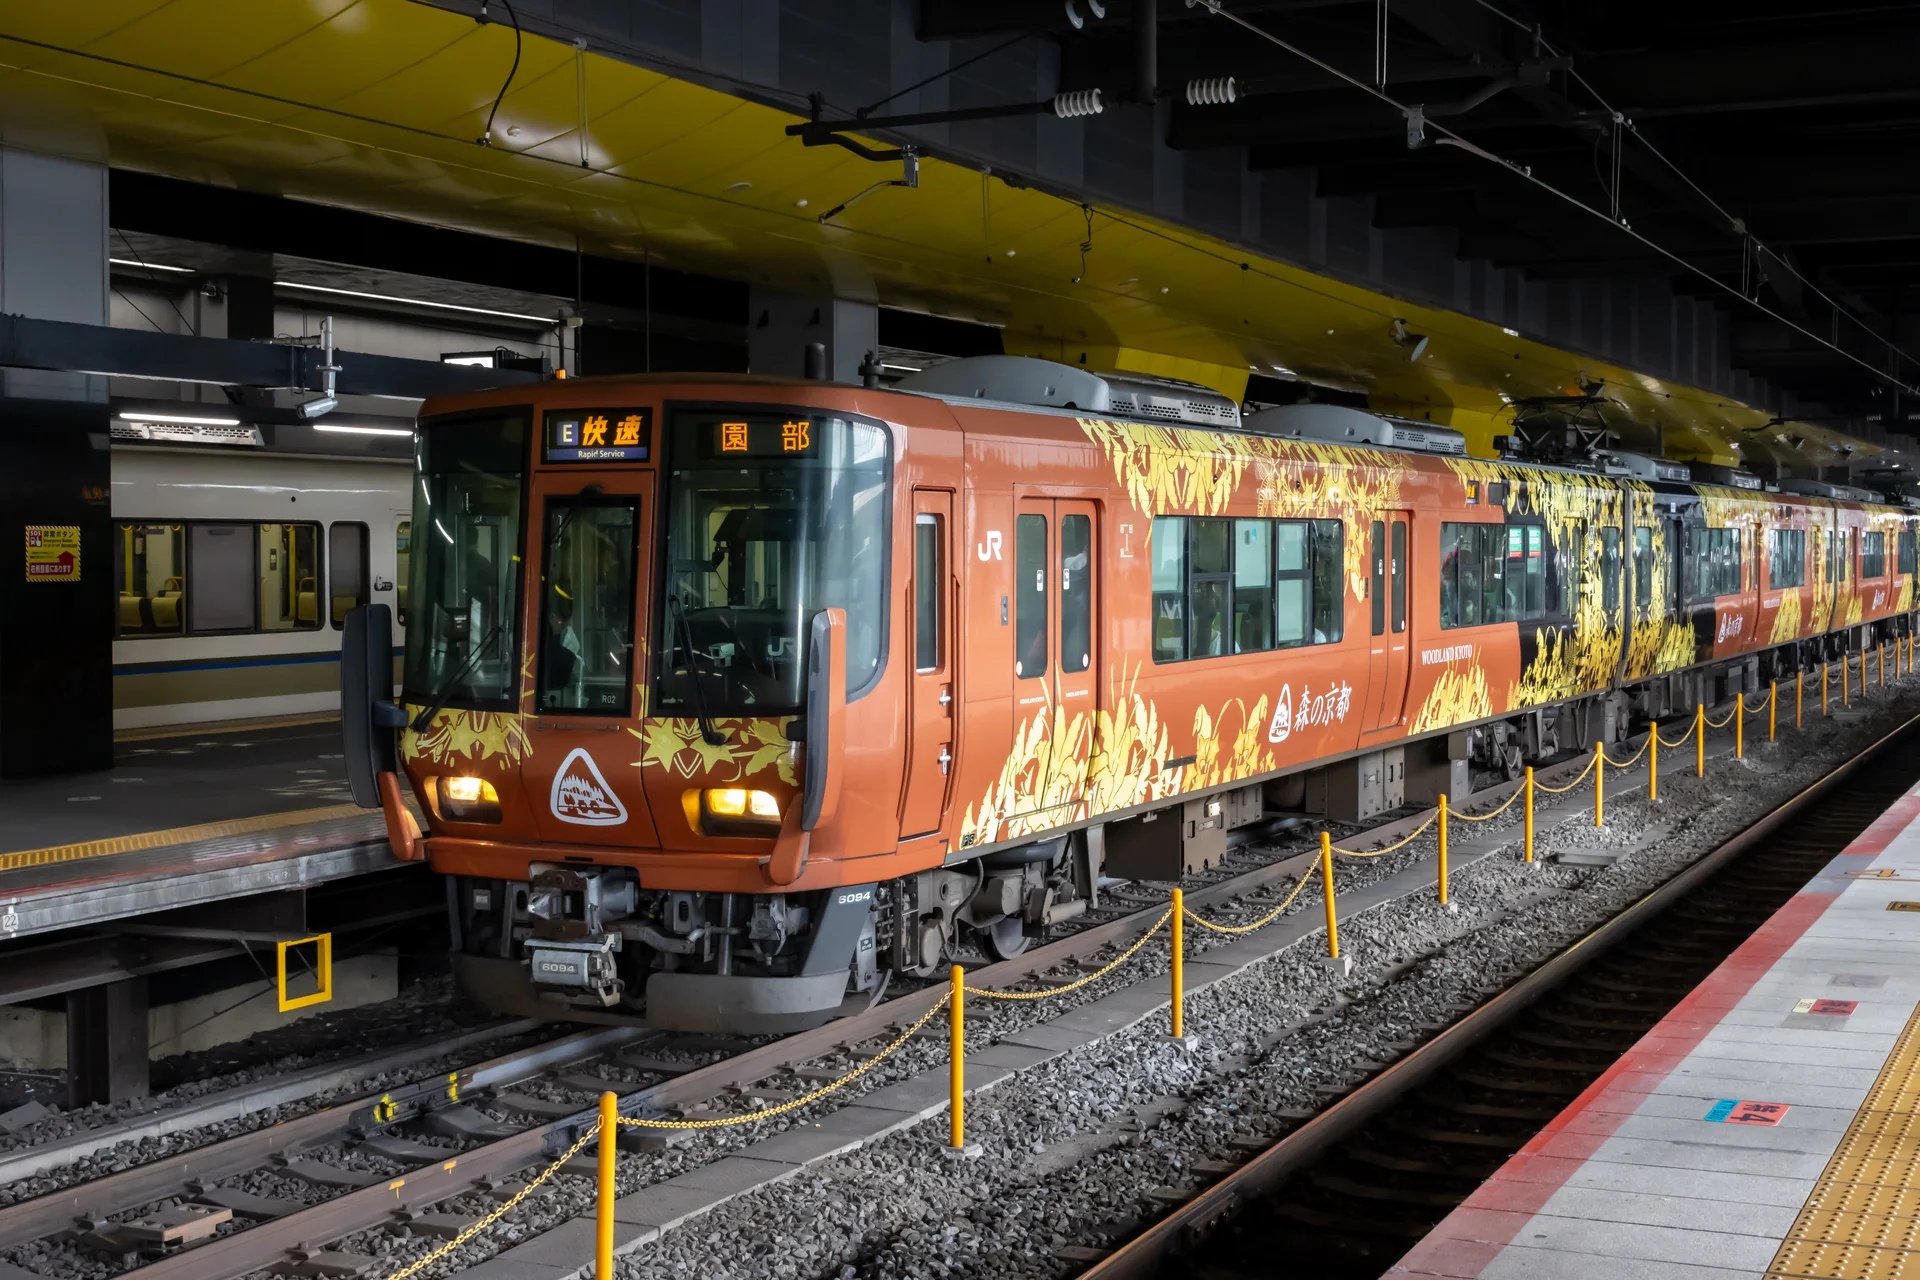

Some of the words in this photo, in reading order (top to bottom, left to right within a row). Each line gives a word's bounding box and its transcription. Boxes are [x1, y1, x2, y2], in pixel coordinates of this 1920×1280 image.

[563, 424, 573, 442] E
[582, 415, 643, 446] 快速
[722, 421, 810, 451] 園部
[578, 450, 598, 459] Rapid
[600, 449, 625, 458] Service
[978, 530, 1002, 561] JR
[1422, 646, 1454, 665] WOODLAND
[1455, 644, 1472, 660] KYOTO
[602, 695, 616, 703] R02
[1293, 680, 1352, 732] 森の京都
[838, 891, 871, 904] 6094
[5, 915, 17, 927] 22
[542, 963, 575, 972] 6094
